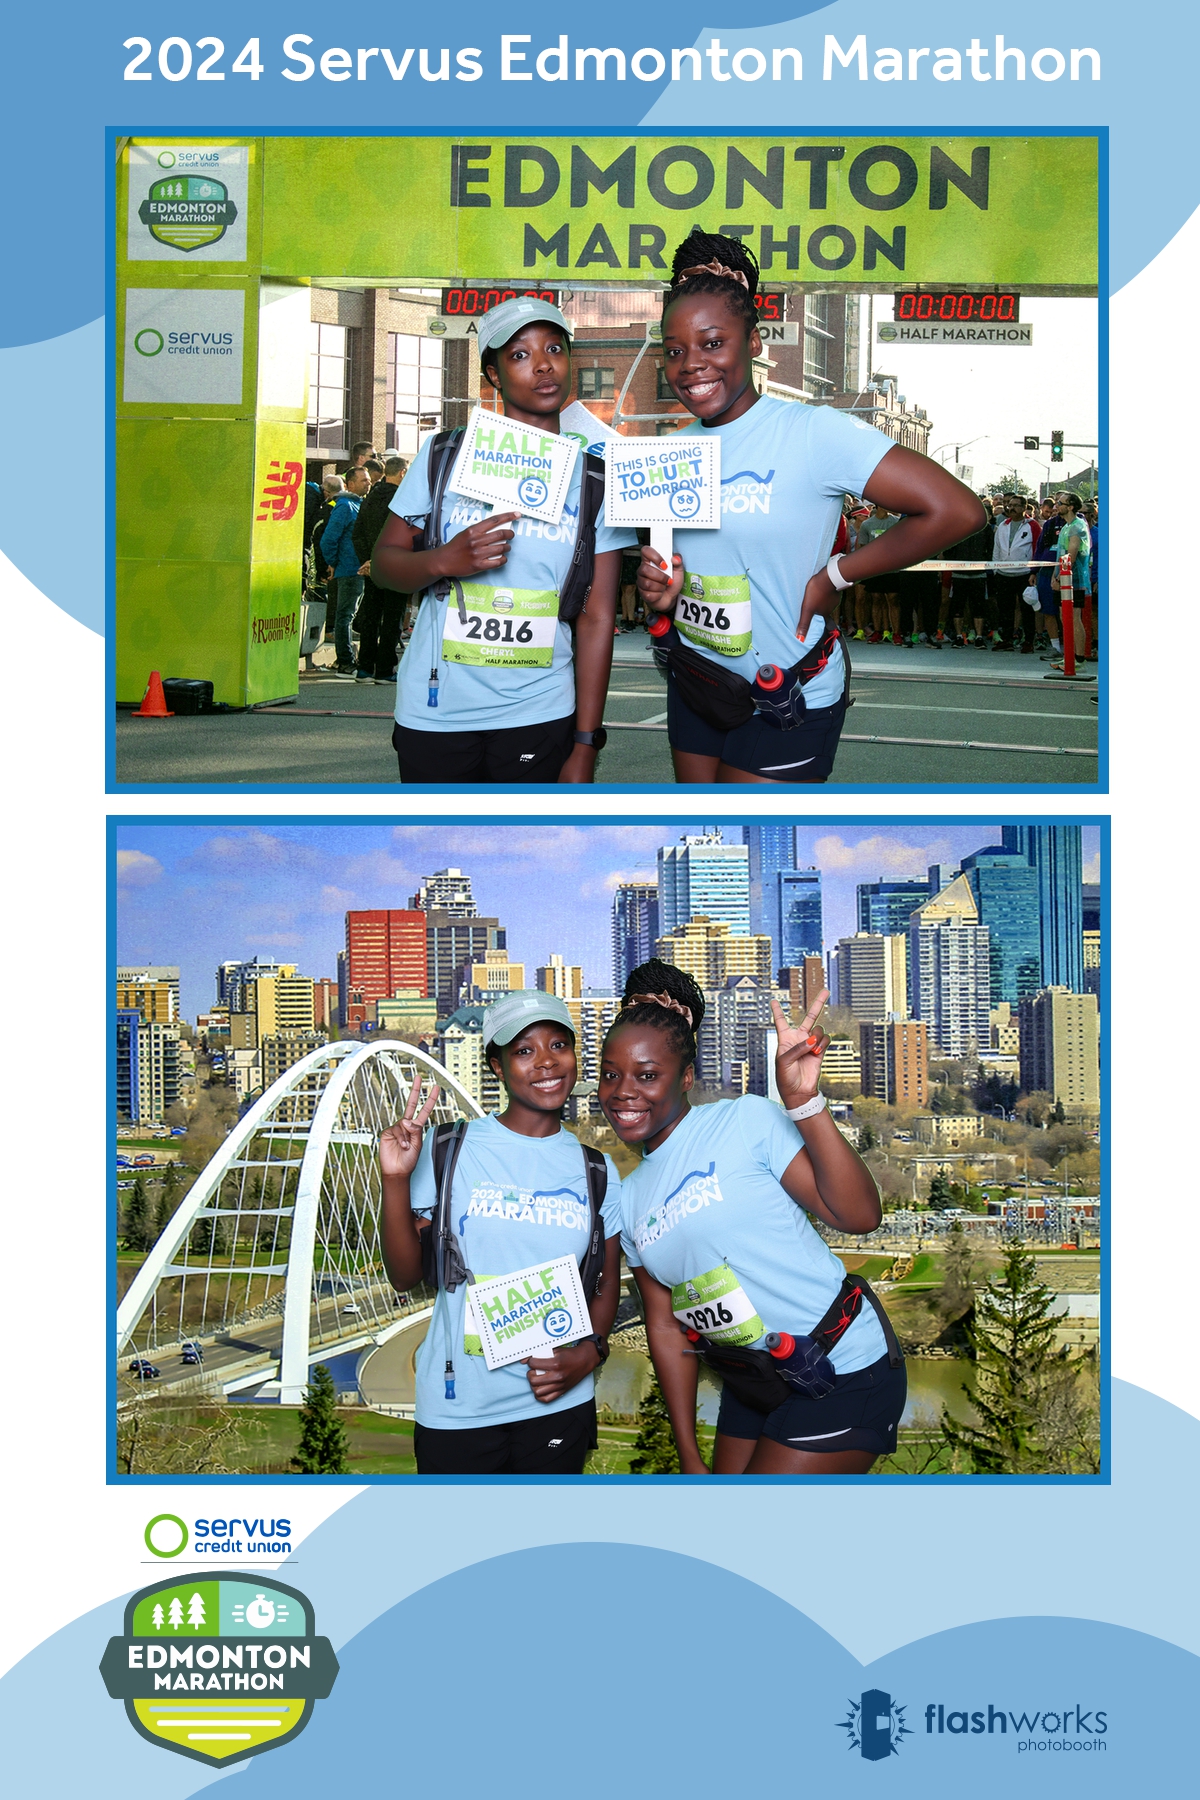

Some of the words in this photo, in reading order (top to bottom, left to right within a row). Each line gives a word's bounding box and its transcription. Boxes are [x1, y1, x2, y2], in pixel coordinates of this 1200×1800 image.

[178, 152, 220, 161] servus
[450, 144, 991, 211] EDMONTON
[149, 202, 226, 214] EDMONTON
[160, 214, 216, 222] MARATHON
[523, 223, 906, 271] MARTHON
[167, 331, 233, 345] servus
[900, 327, 938, 340] HALF
[942, 328, 1031, 341] MARATHON
[167, 344, 200, 355] credit
[202, 346, 233, 355] union
[475, 427, 554, 457] HALF
[472, 461, 552, 483] FINISHER!
[474, 449, 552, 470] MARATHON
[614, 458, 643, 473] THIS
[646, 455, 656, 467] IS
[659, 446, 702, 464] GOING
[617, 471, 646, 489] TO
[649, 459, 703, 484] HURT
[619, 476, 707, 502] TOMORROW.
[257, 613, 291, 643] Running
[465, 615, 534, 643] 2816
[680, 598, 731, 631] 2926
[480, 646, 515, 657] CHERYL
[471, 1188, 503, 1200] 2024
[519, 1193, 589, 1216] EDMONTON
[655, 1172, 719, 1221] EDMONTON
[466, 1199, 588, 1233] MARATHON
[634, 1184, 724, 1254] MARATHON
[481, 1266, 555, 1322] HALF
[490, 1286, 563, 1332] MARATHON
[494, 1296, 569, 1344] FINISHER!
[686, 1301, 734, 1331] 2926
